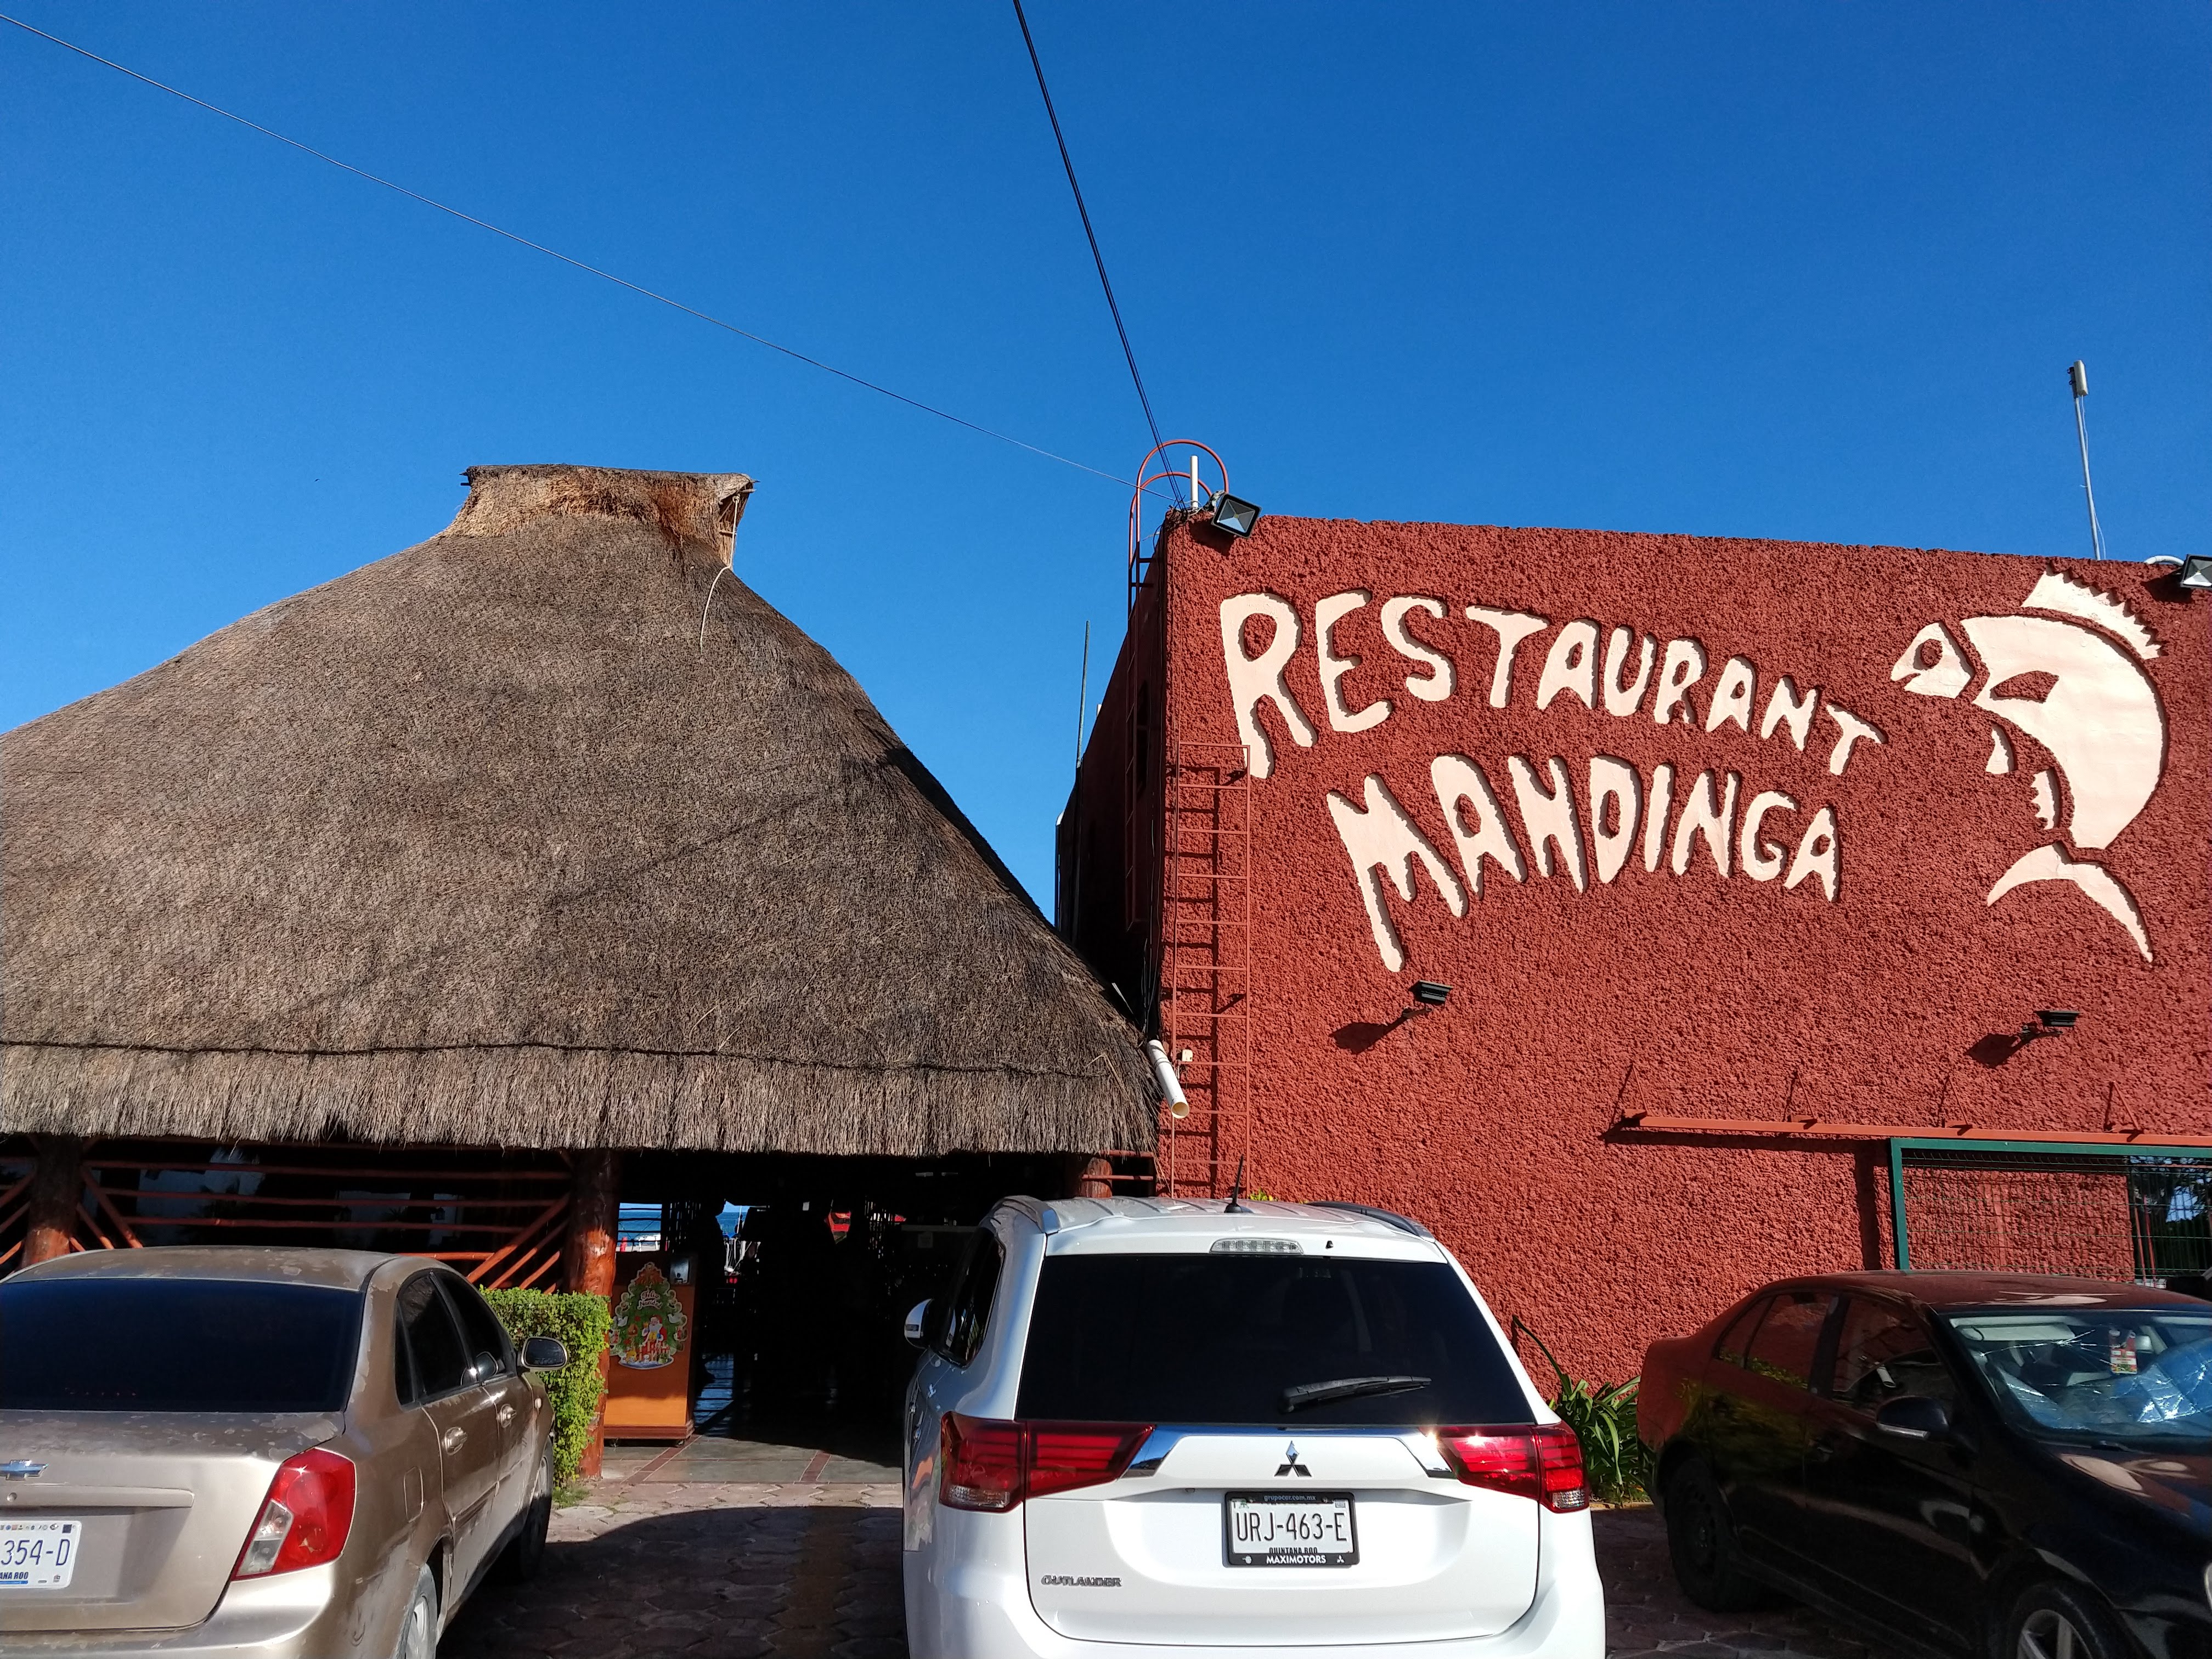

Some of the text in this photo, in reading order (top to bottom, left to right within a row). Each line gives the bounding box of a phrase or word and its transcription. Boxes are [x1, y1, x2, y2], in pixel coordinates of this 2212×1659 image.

[1220, 589, 1886, 779] RESTAURANT
[1326, 754, 1839, 973] MANDINGA
[1236, 1512, 1347, 1542] URJ-463-E
[1266, 1555, 1327, 1564] MAXIMOTORS
[14, 1571, 29, 1579] ROO
[1041, 1575, 1122, 1587] OUTLANDER
